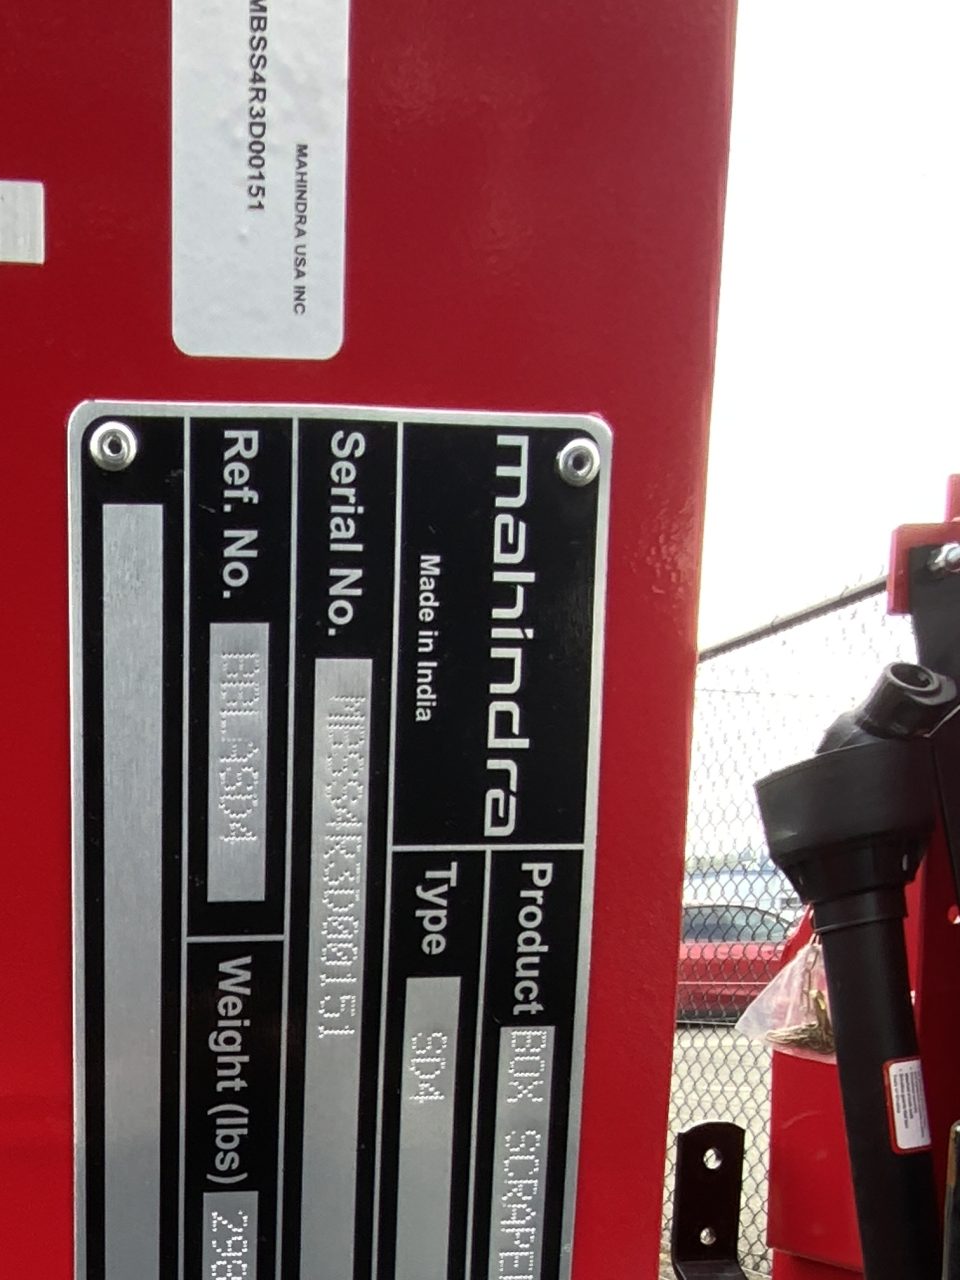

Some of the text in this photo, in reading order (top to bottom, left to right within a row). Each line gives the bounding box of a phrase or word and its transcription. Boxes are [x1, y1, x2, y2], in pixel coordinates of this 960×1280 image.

[292, 143, 309, 316] MAHINDRA USA INC
[222, 428, 260, 513] Ref.
[222, 528, 259, 600] No.
[414, 554, 442, 723] Made in India
[482, 433, 537, 838] mahindra
[317, 429, 367, 1040] Serial No. MBSS4R3D00151
[408, 861, 459, 1104] Type SD4
[513, 861, 555, 1016] Product
[207, 955, 253, 1093] Weight
[506, 1029, 548, 1104] BOX
[205, 1102, 249, 1186] (lbs)
